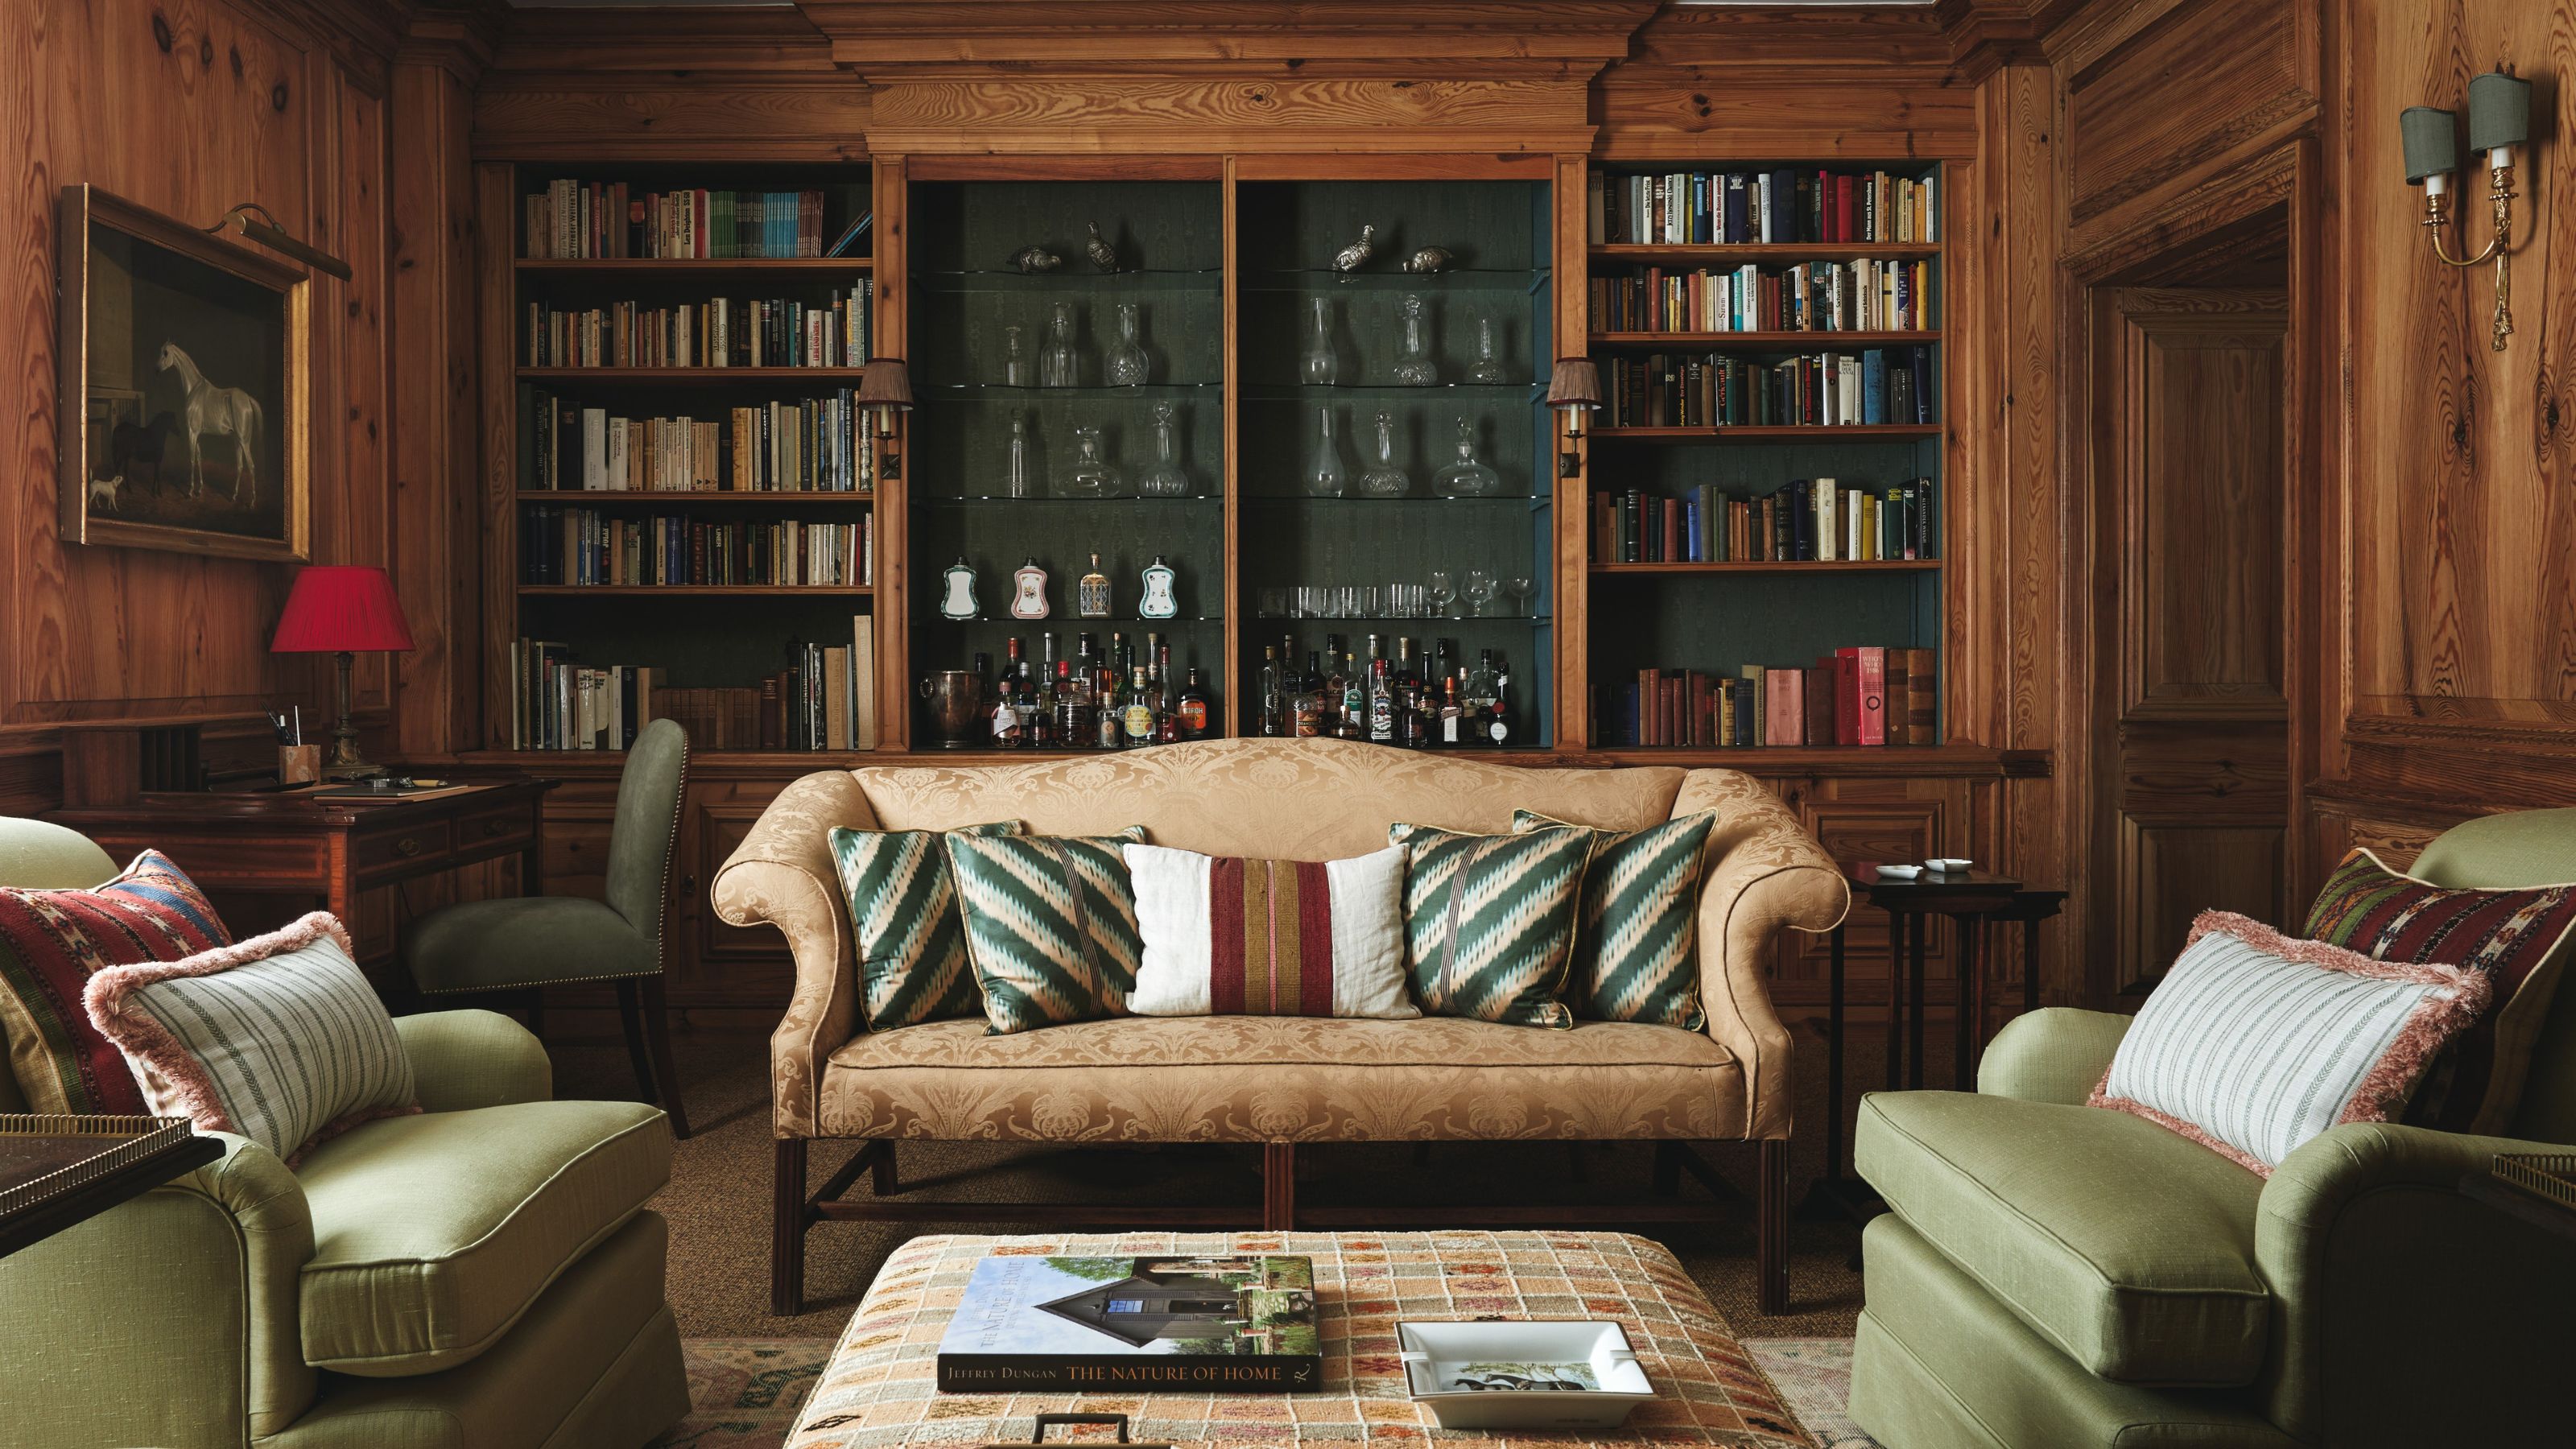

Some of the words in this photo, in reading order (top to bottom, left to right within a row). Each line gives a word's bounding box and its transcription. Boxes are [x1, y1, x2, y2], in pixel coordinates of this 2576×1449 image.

[683, 208, 691, 233] Deighton
[948, 1367, 996, 1380] JEFFREY
[1002, 1367, 1057, 1379] DUNGAN
[1067, 1366, 1105, 1380] THE
[1112, 1366, 1188, 1380] NATURE
[1193, 1366, 1218, 1381] OF
[1224, 1366, 1282, 1380] HOME
